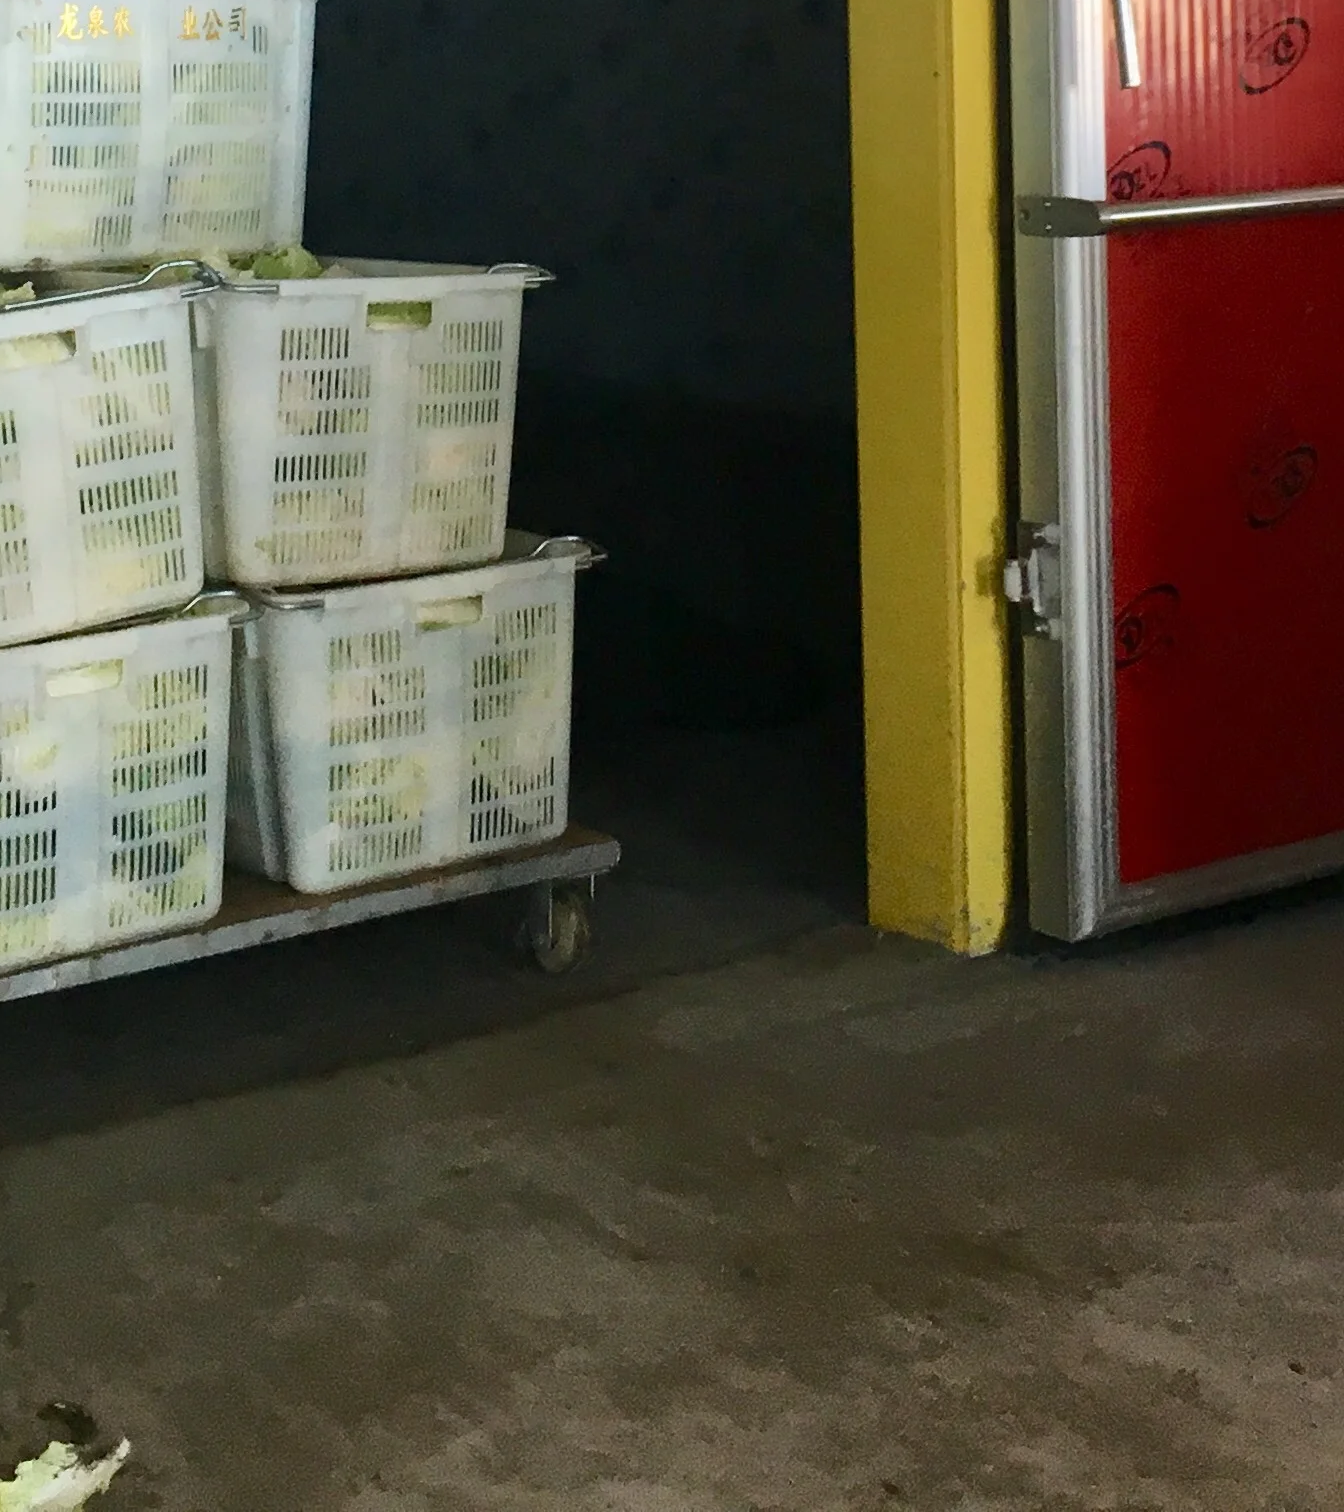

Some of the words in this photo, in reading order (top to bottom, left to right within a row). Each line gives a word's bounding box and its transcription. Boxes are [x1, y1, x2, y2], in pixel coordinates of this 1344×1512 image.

[57, 2, 248, 41] 龙泉农业公司
